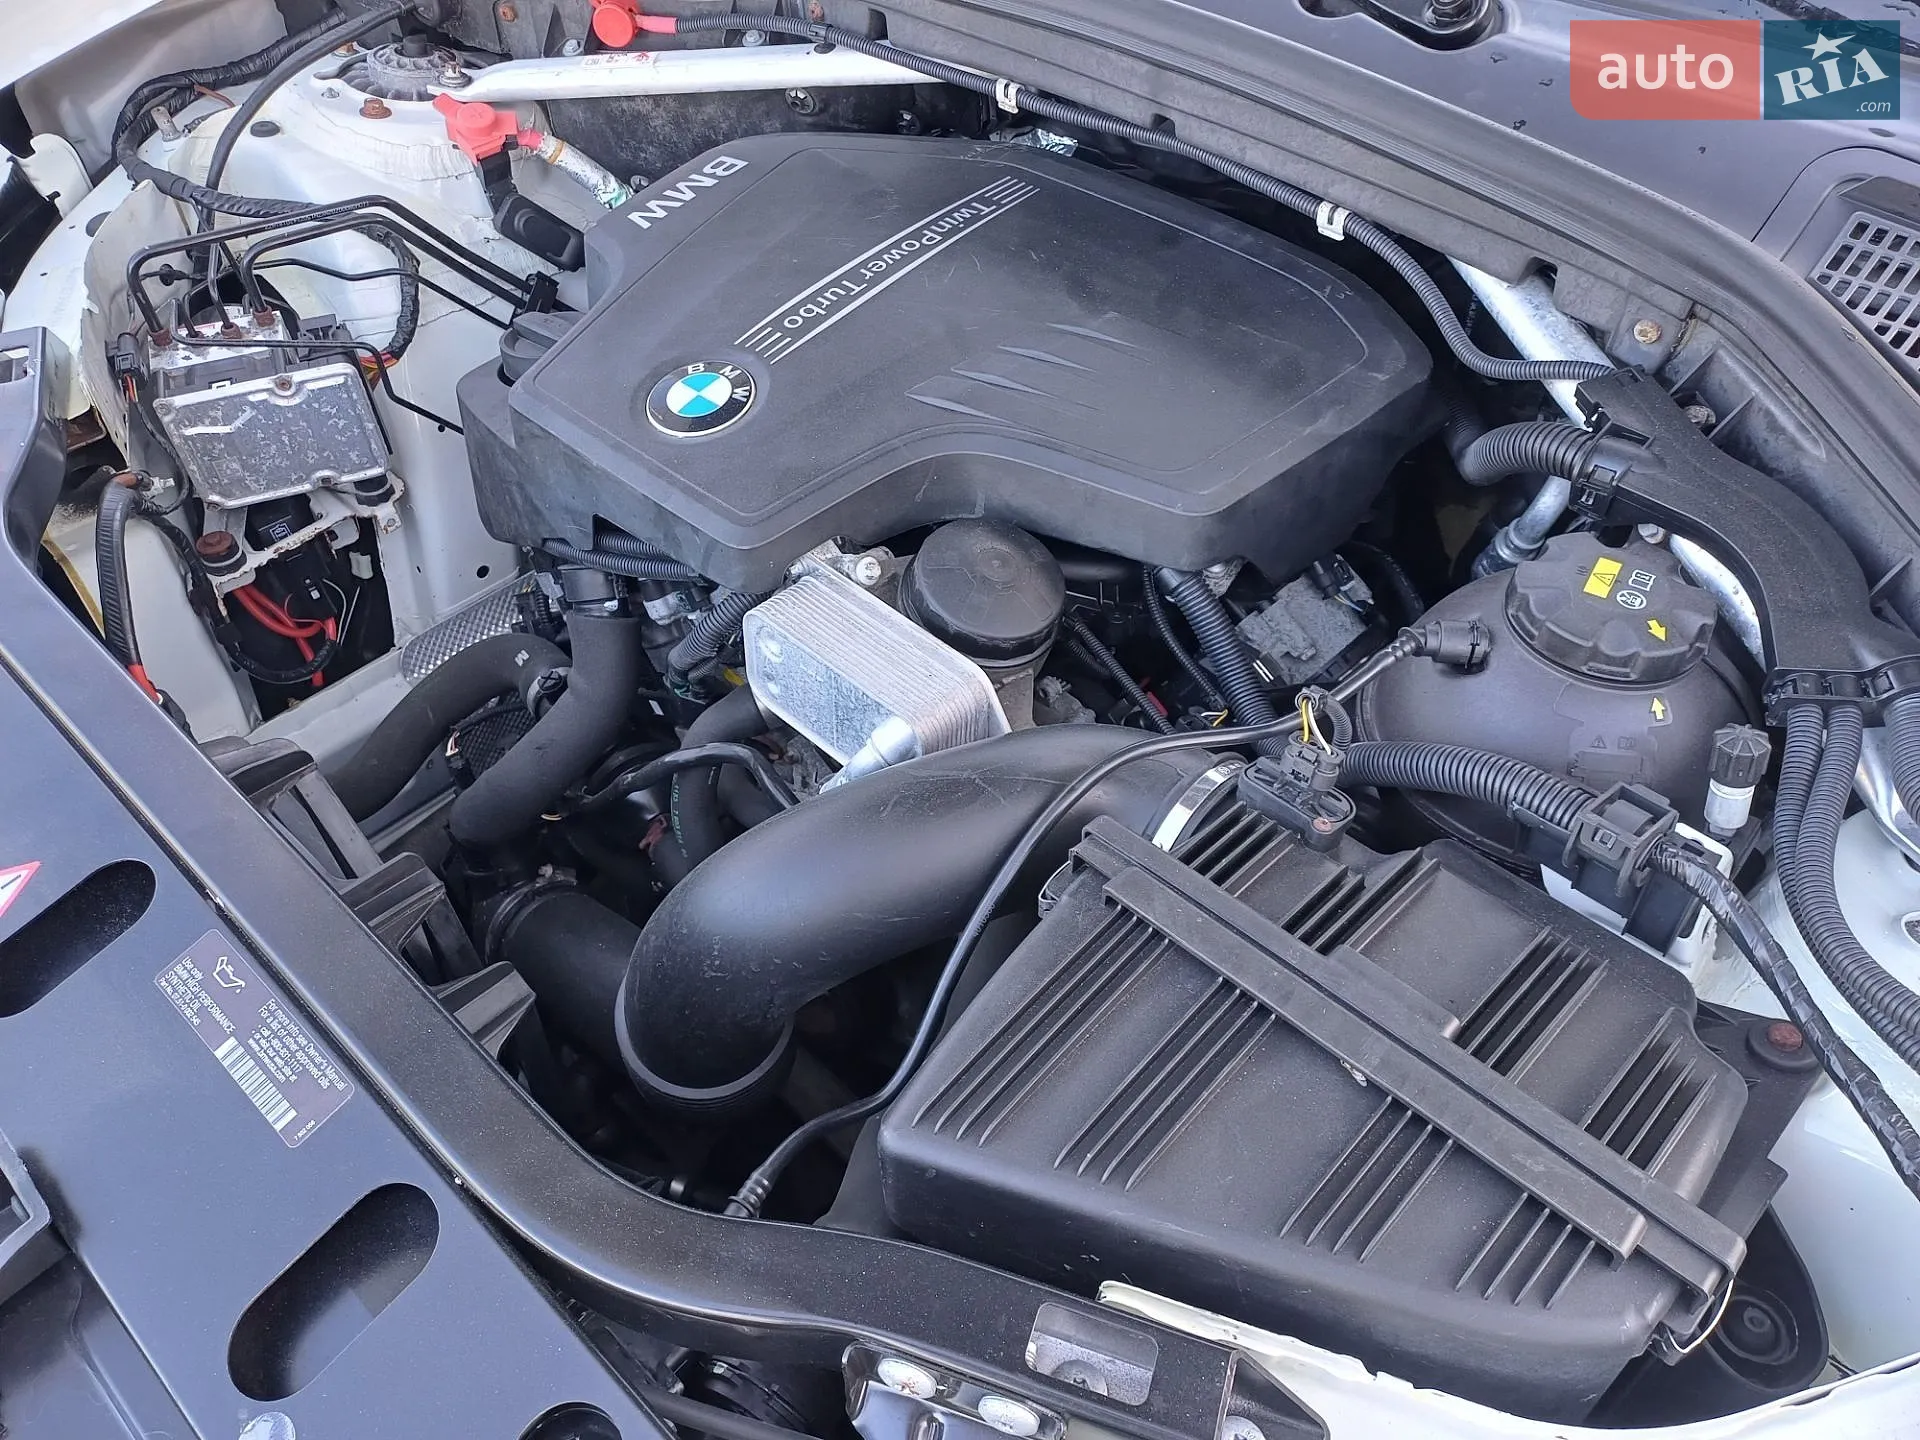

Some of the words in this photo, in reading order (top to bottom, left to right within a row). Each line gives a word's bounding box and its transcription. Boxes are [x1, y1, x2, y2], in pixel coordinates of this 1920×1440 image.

[627, 156, 749, 229] BMW
[688, 363, 750, 402] BMW
[181, 956, 194, 970] Use
[190, 967, 204, 981] only
[165, 970, 194, 1003] SYNTHETIC
[189, 999, 202, 1013] OIL
[173, 963, 191, 980] BMW
[184, 976, 202, 995] HIGH
[196, 990, 236, 1034] PERFORMANCE
[257, 1005, 270, 1018] For
[269, 1019, 281, 1032] list
[260, 1026, 272, 1038] call
[265, 998, 278, 1012] For
[274, 1009, 290, 1026] more
[295, 1034, 308, 1047] see
[304, 1043, 328, 1069] Owner's
[323, 1065, 348, 1091] Manual
[277, 1028, 288, 1038] of
[282, 1035, 299, 1052] other
[247, 1037, 286, 1083] www.bmwusa.com
[258, 1037, 270, 1050] visit
[266, 1047, 276, 1057] our
[273, 1055, 284, 1068] web
[281, 1065, 292, 1077] site
[295, 1049, 323, 1079] approved
[317, 1076, 330, 1089] oils
